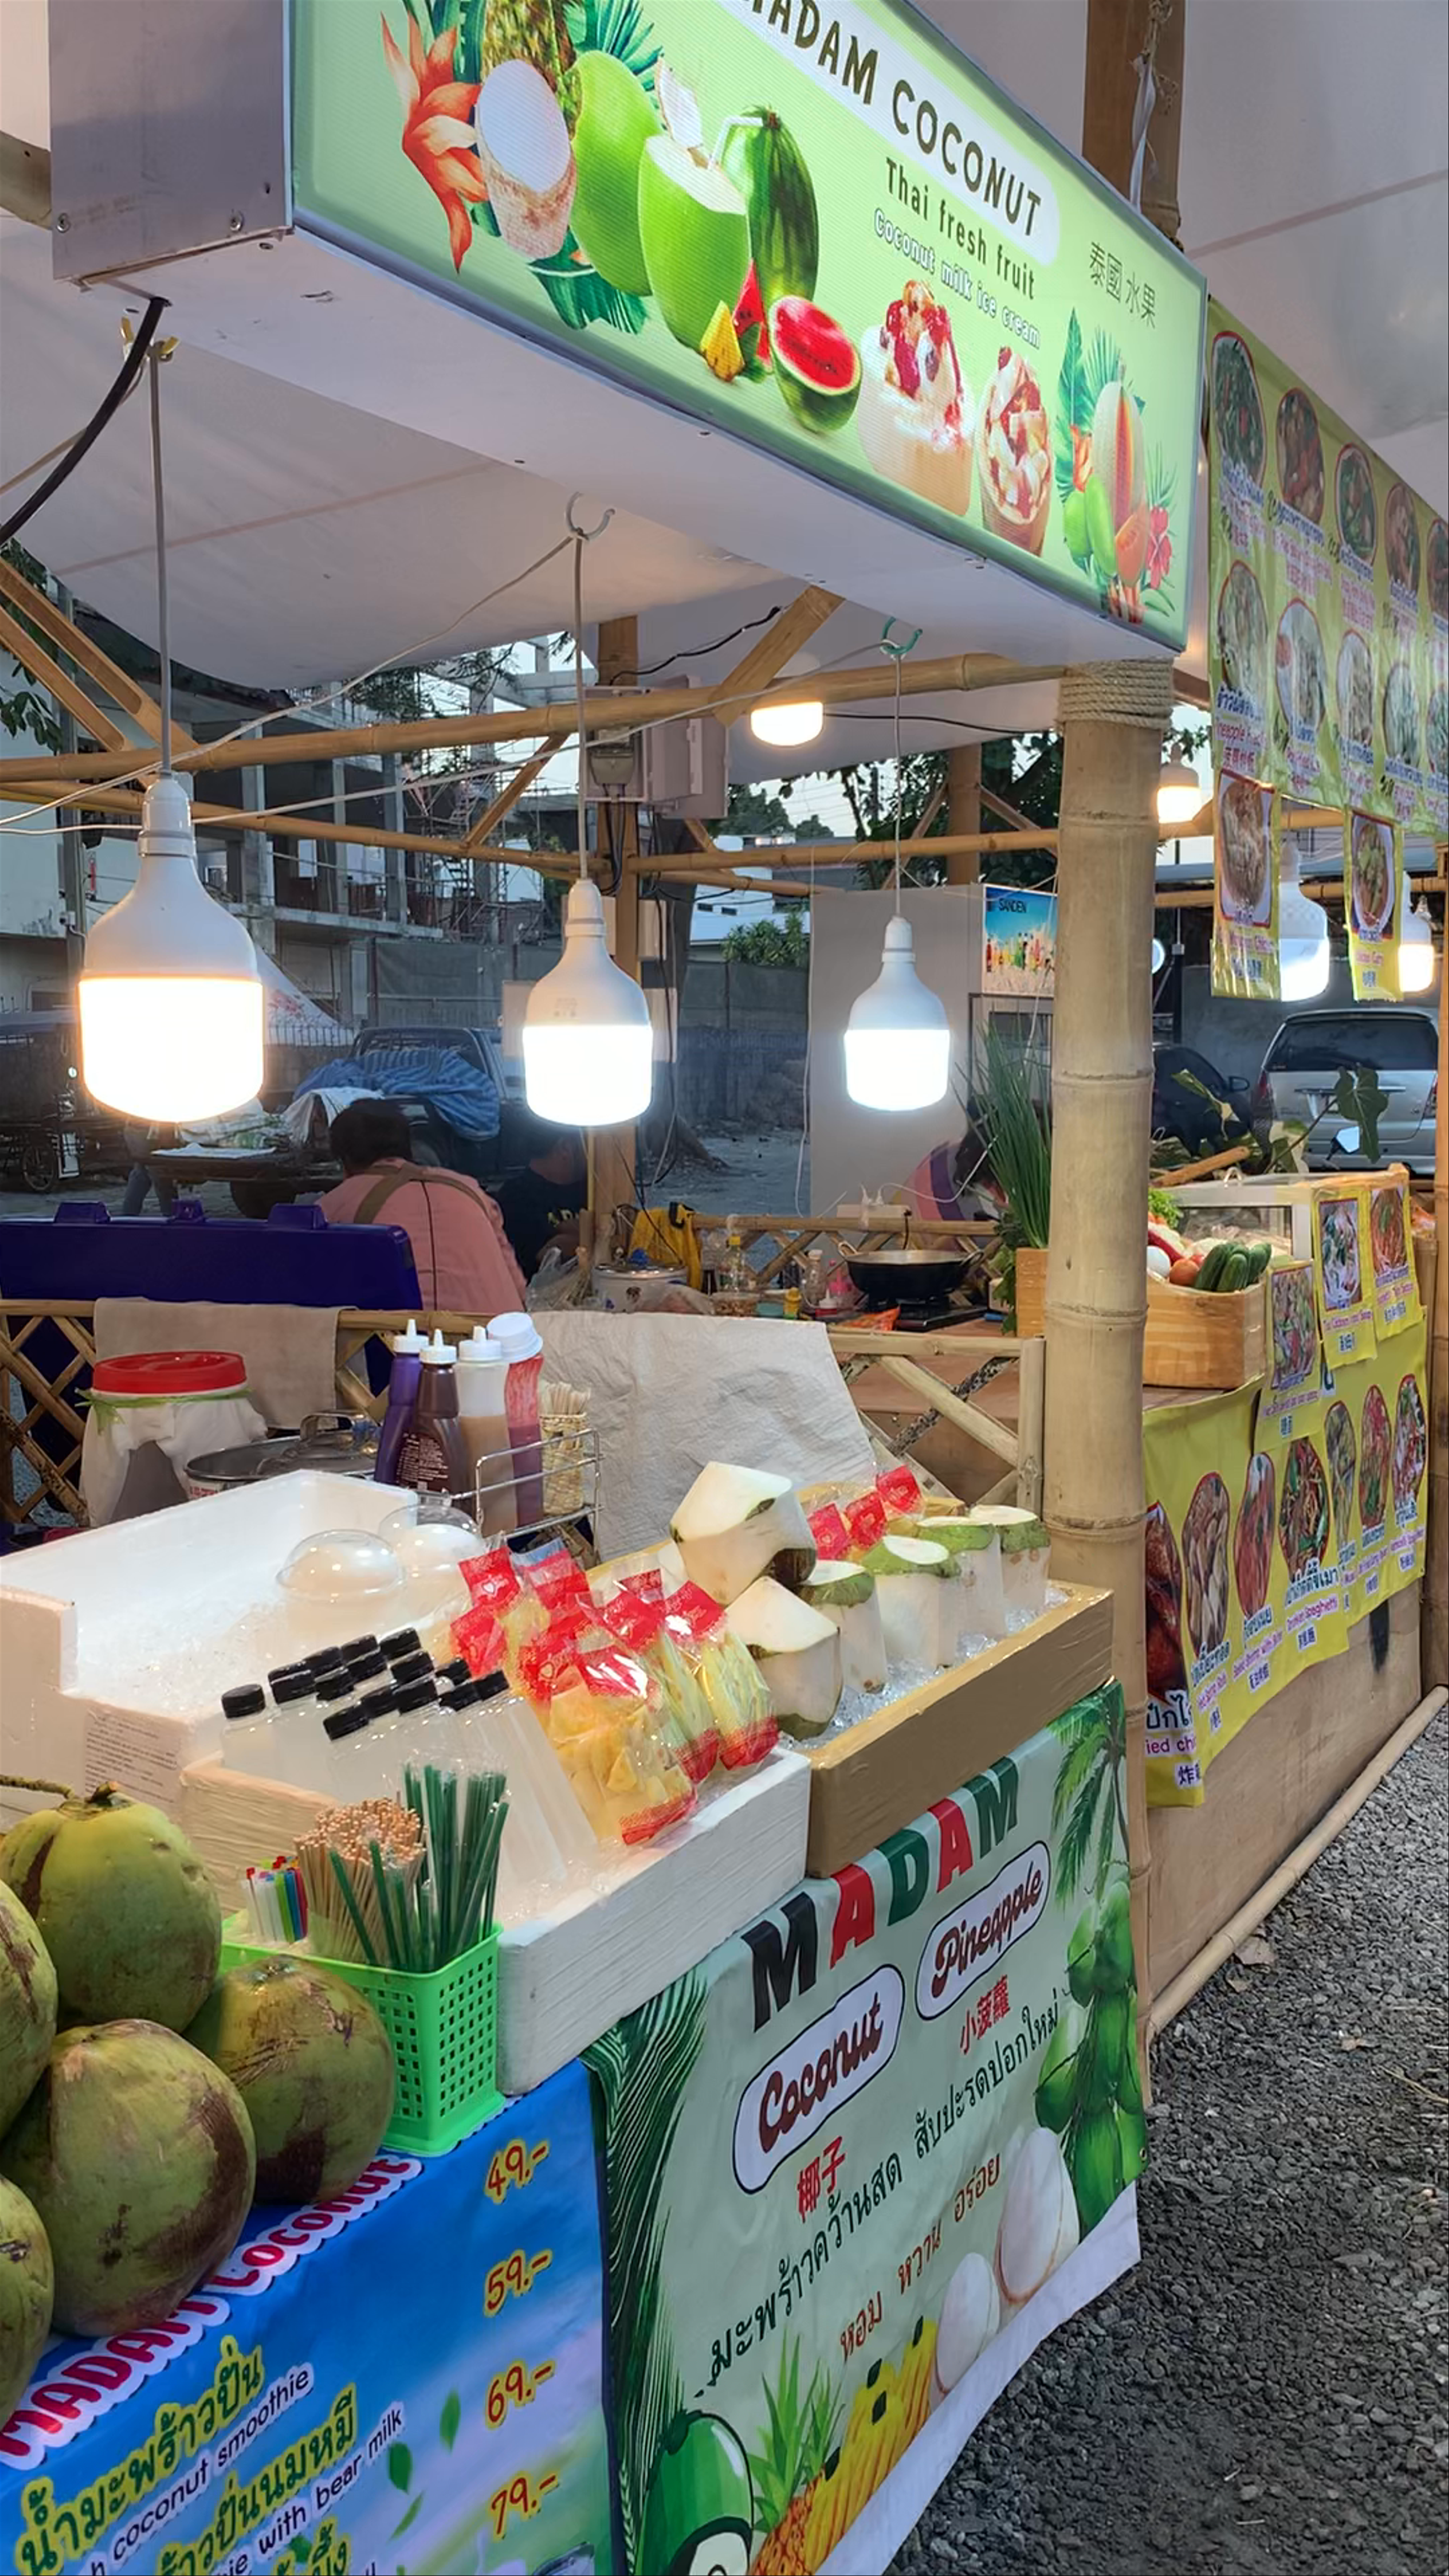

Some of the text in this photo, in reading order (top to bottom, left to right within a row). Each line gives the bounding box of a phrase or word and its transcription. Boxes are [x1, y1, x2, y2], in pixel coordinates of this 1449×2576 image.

[744, 0, 1041, 236] ADAM COCONUT
[886, 157, 1035, 300] Thai fresh fruit
[1089, 241, 1156, 329] 泰國水果
[941, 261, 973, 301] milk
[976, 281, 997, 318] ice
[1002, 306, 1040, 349] cream
[1145, 1738, 1170, 1755] ied
[740, 1756, 1019, 2033] MADAM
[931, 1861, 1044, 1998] Pineapple
[759, 1991, 884, 2153] Coconut
[488, 2145, 546, 2196] 49.-
[708, 1987, 1058, 2384] มะพร้าวคว้านสด สับปะรดปอกใหม่
[797, 2136, 846, 2224] 椰子
[487, 2255, 549, 2310] 59.-
[840, 2153, 1000, 2364] หอม หวาน อร่อย
[488, 2365, 552, 2423] 69.-
[114, 2458, 209, 2561] coconut
[217, 2369, 309, 2468] smoothie
[258, 2505, 307, 2555] with
[316, 2455, 362, 2510] bear
[368, 2408, 403, 2458] milk
[491, 2474, 557, 2535] 79.-
